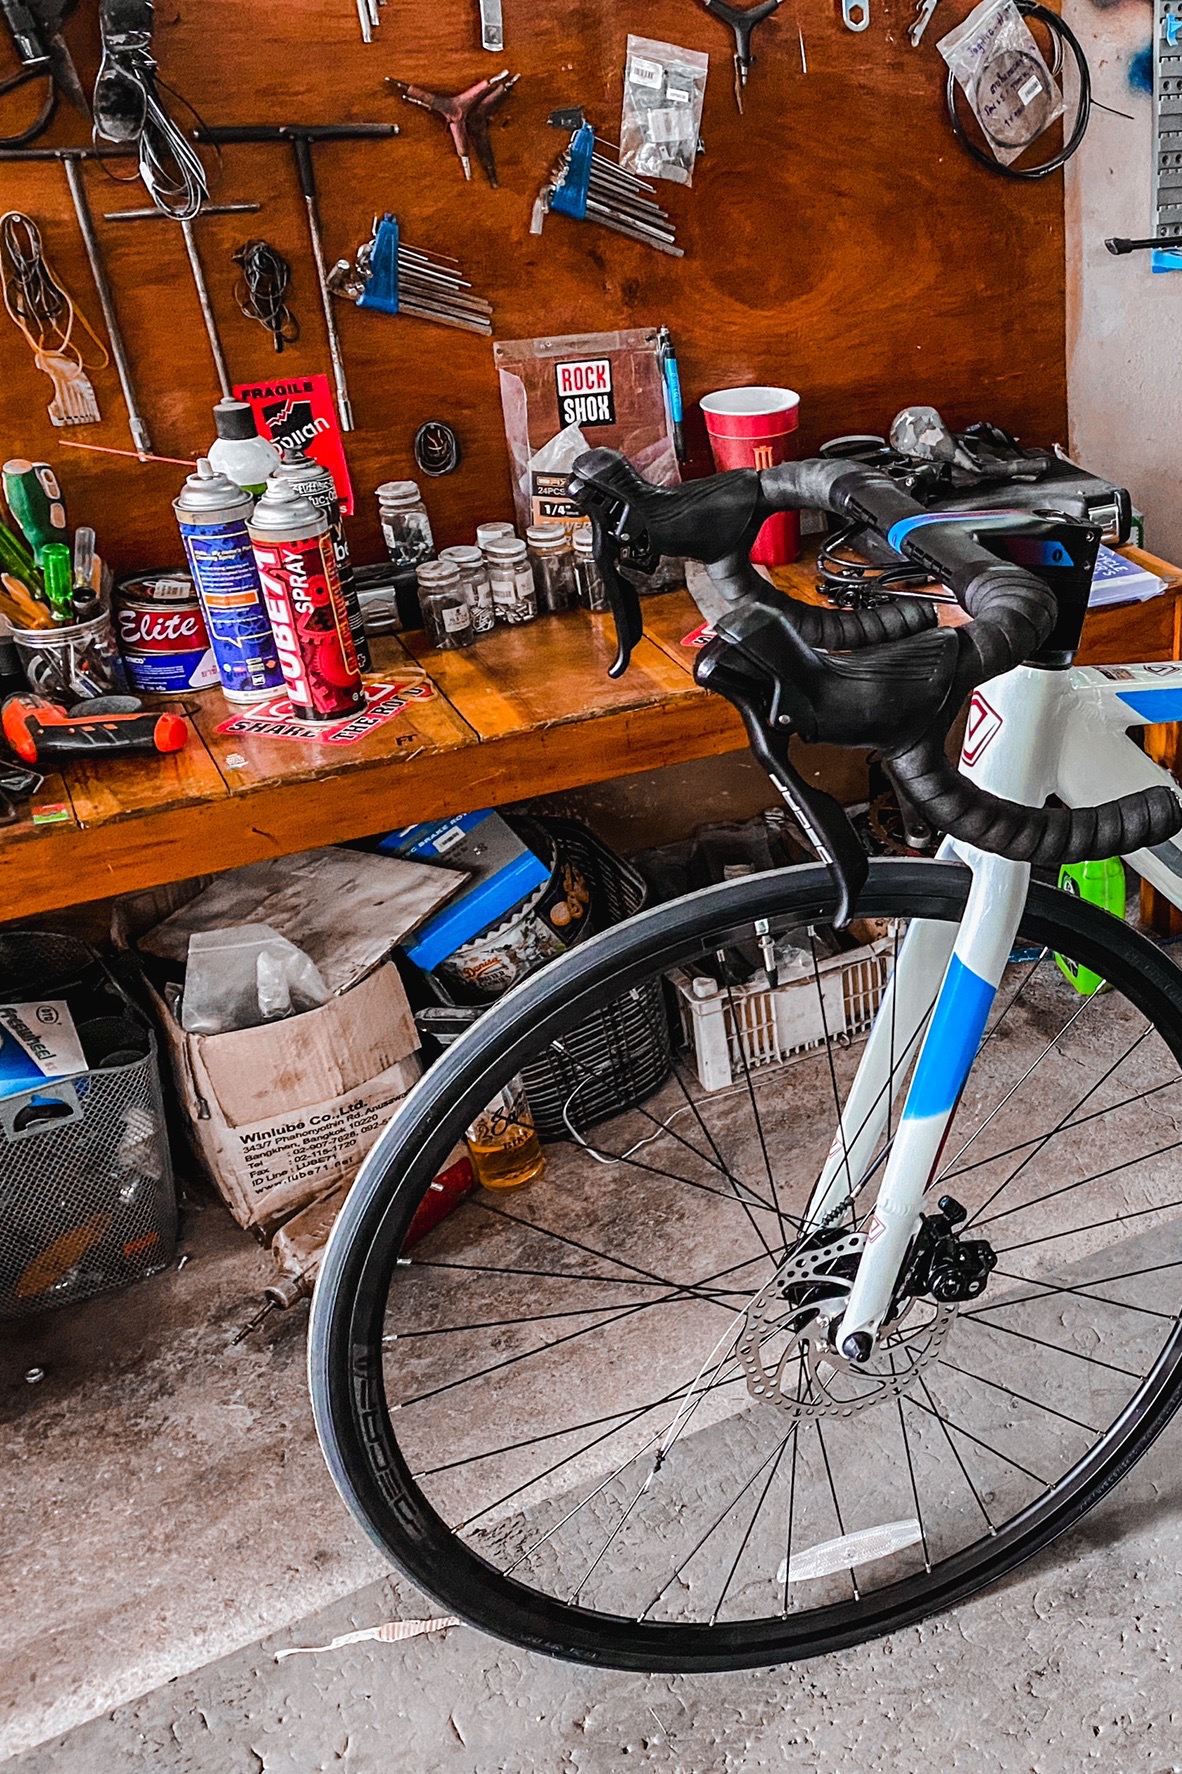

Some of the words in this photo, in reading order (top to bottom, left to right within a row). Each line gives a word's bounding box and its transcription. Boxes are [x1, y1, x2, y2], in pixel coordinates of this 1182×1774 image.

[241, 382, 314, 400] FRAGILE
[561, 365, 607, 392] ROCK
[281, 550, 315, 615] SPRAY
[118, 610, 199, 642] Elite
[254, 548, 313, 704] LUBE71
[226, 720, 323, 739] SHARE
[328, 715, 380, 741] THE
[418, 825, 449, 848] BRAKE
[463, 956, 502, 979] Danisa
[239, 1121, 306, 1145] Winlube
[309, 1099, 368, 1125] Co.,Ltd.
[242, 1138, 272, 1154] 343/7
[275, 1118, 344, 1146] Phahonyothin
[302, 1126, 346, 1146] Bangkok
[349, 1113, 379, 1129] 10220
[248, 1160, 263, 1170] Tel
[249, 1168, 270, 1179] Fax
[251, 1177, 264, 1188] ID
[266, 1169, 288, 1182] Line
[296, 1153, 337, 1170] LUBE71
[254, 1156, 354, 1195] www.lube71.net
